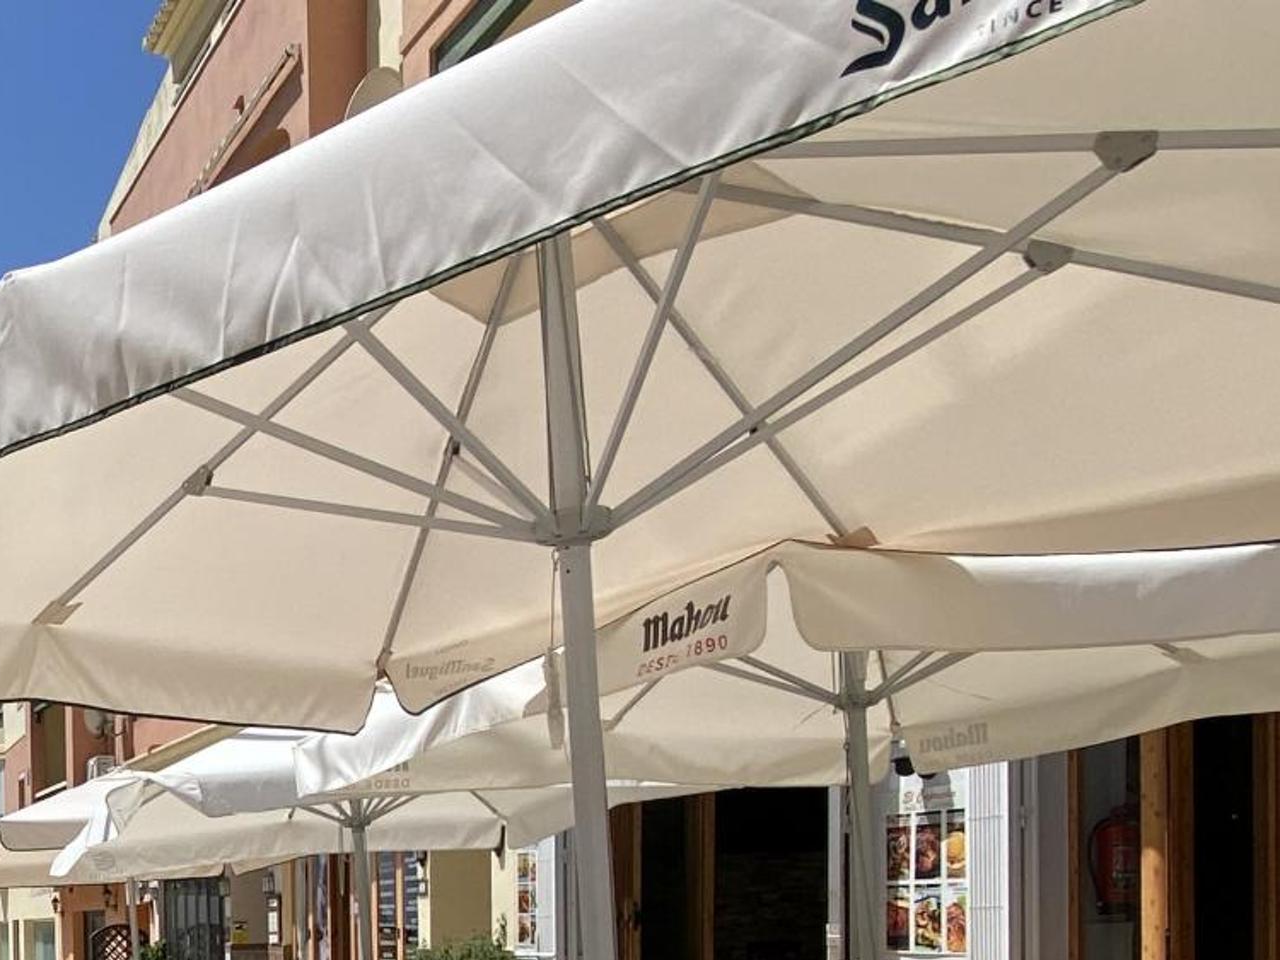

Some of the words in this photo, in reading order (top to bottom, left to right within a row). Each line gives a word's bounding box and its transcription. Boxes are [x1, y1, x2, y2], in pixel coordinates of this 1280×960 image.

[840, 0, 969, 77] Sa
[643, 595, 731, 652] Mahou
[687, 635, 728, 657] 1890
